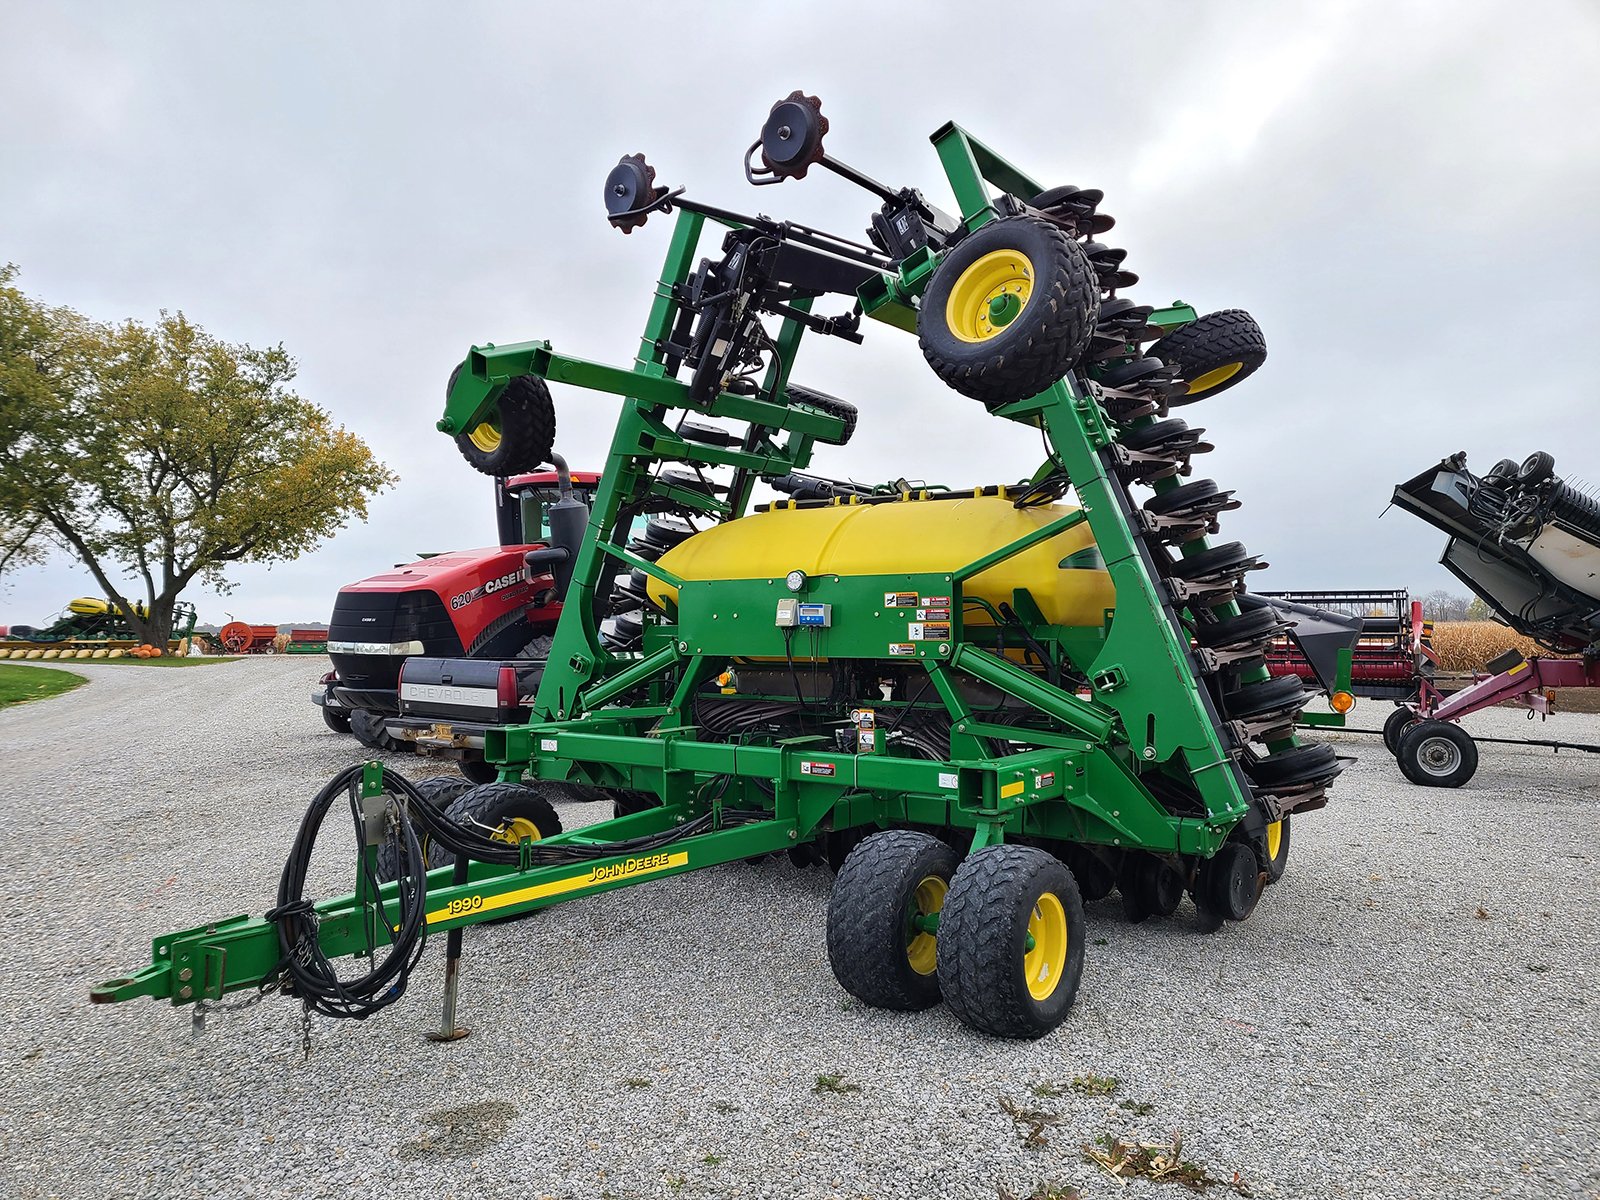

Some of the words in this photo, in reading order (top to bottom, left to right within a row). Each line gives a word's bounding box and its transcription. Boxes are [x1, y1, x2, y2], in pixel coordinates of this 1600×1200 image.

[485, 573, 516, 594] CASE
[451, 591, 472, 610] 620
[409, 687, 488, 702] CHEVROLET
[589, 863, 626, 882] JOHN
[626, 853, 670, 874] DEERE
[447, 895, 483, 914] 1990
